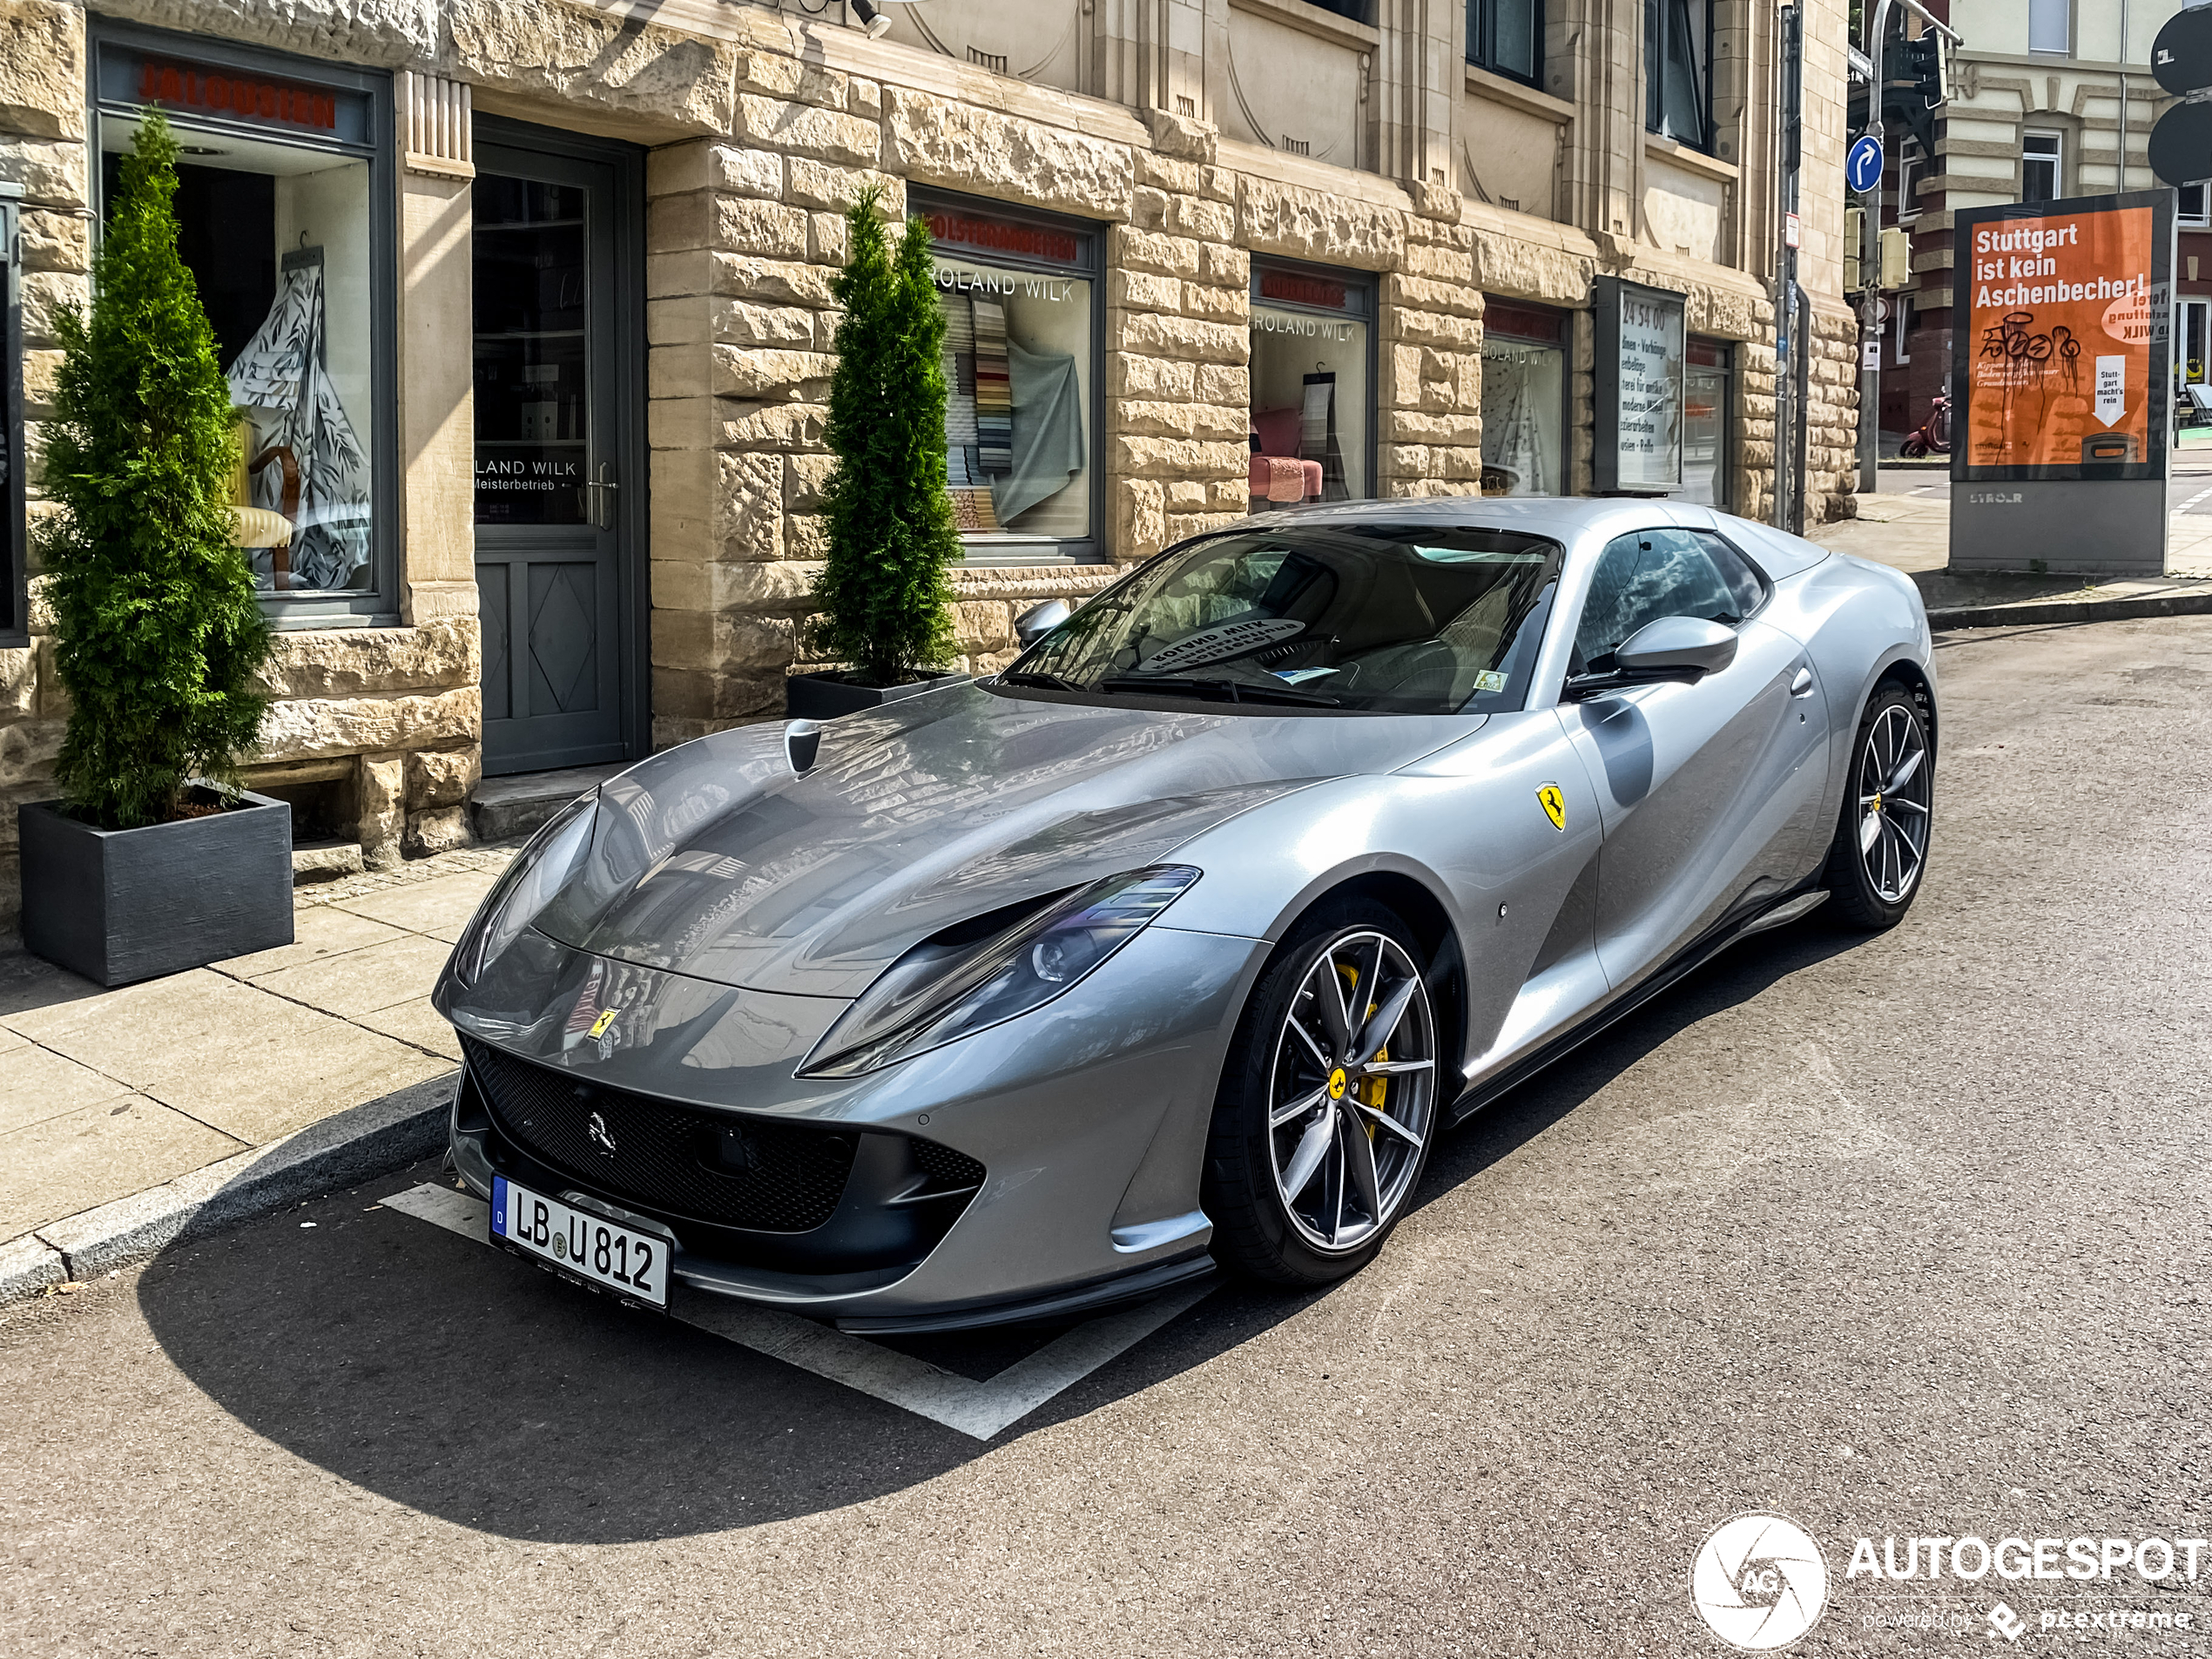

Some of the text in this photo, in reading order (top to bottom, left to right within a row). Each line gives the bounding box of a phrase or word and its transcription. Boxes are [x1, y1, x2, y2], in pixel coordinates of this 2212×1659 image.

[138, 63, 335, 129] JALOUSIEN
[1977, 224, 2077, 253] Stuttgart
[1977, 253, 2056, 281] ist kein
[927, 266, 1073, 303] ROLAND WILK
[1976, 273, 2144, 308] Aschenbecher!
[1254, 314, 1355, 343] ROLAND WILK
[1638, 305, 1650, 329] 54
[1482, 344, 1554, 367] ROLAND WILK
[2103, 380, 2117, 388] gart
[532, 462, 576, 475] WILK
[497, 1211, 503, 1224] D
[516, 1191, 653, 1292] LB U 812
